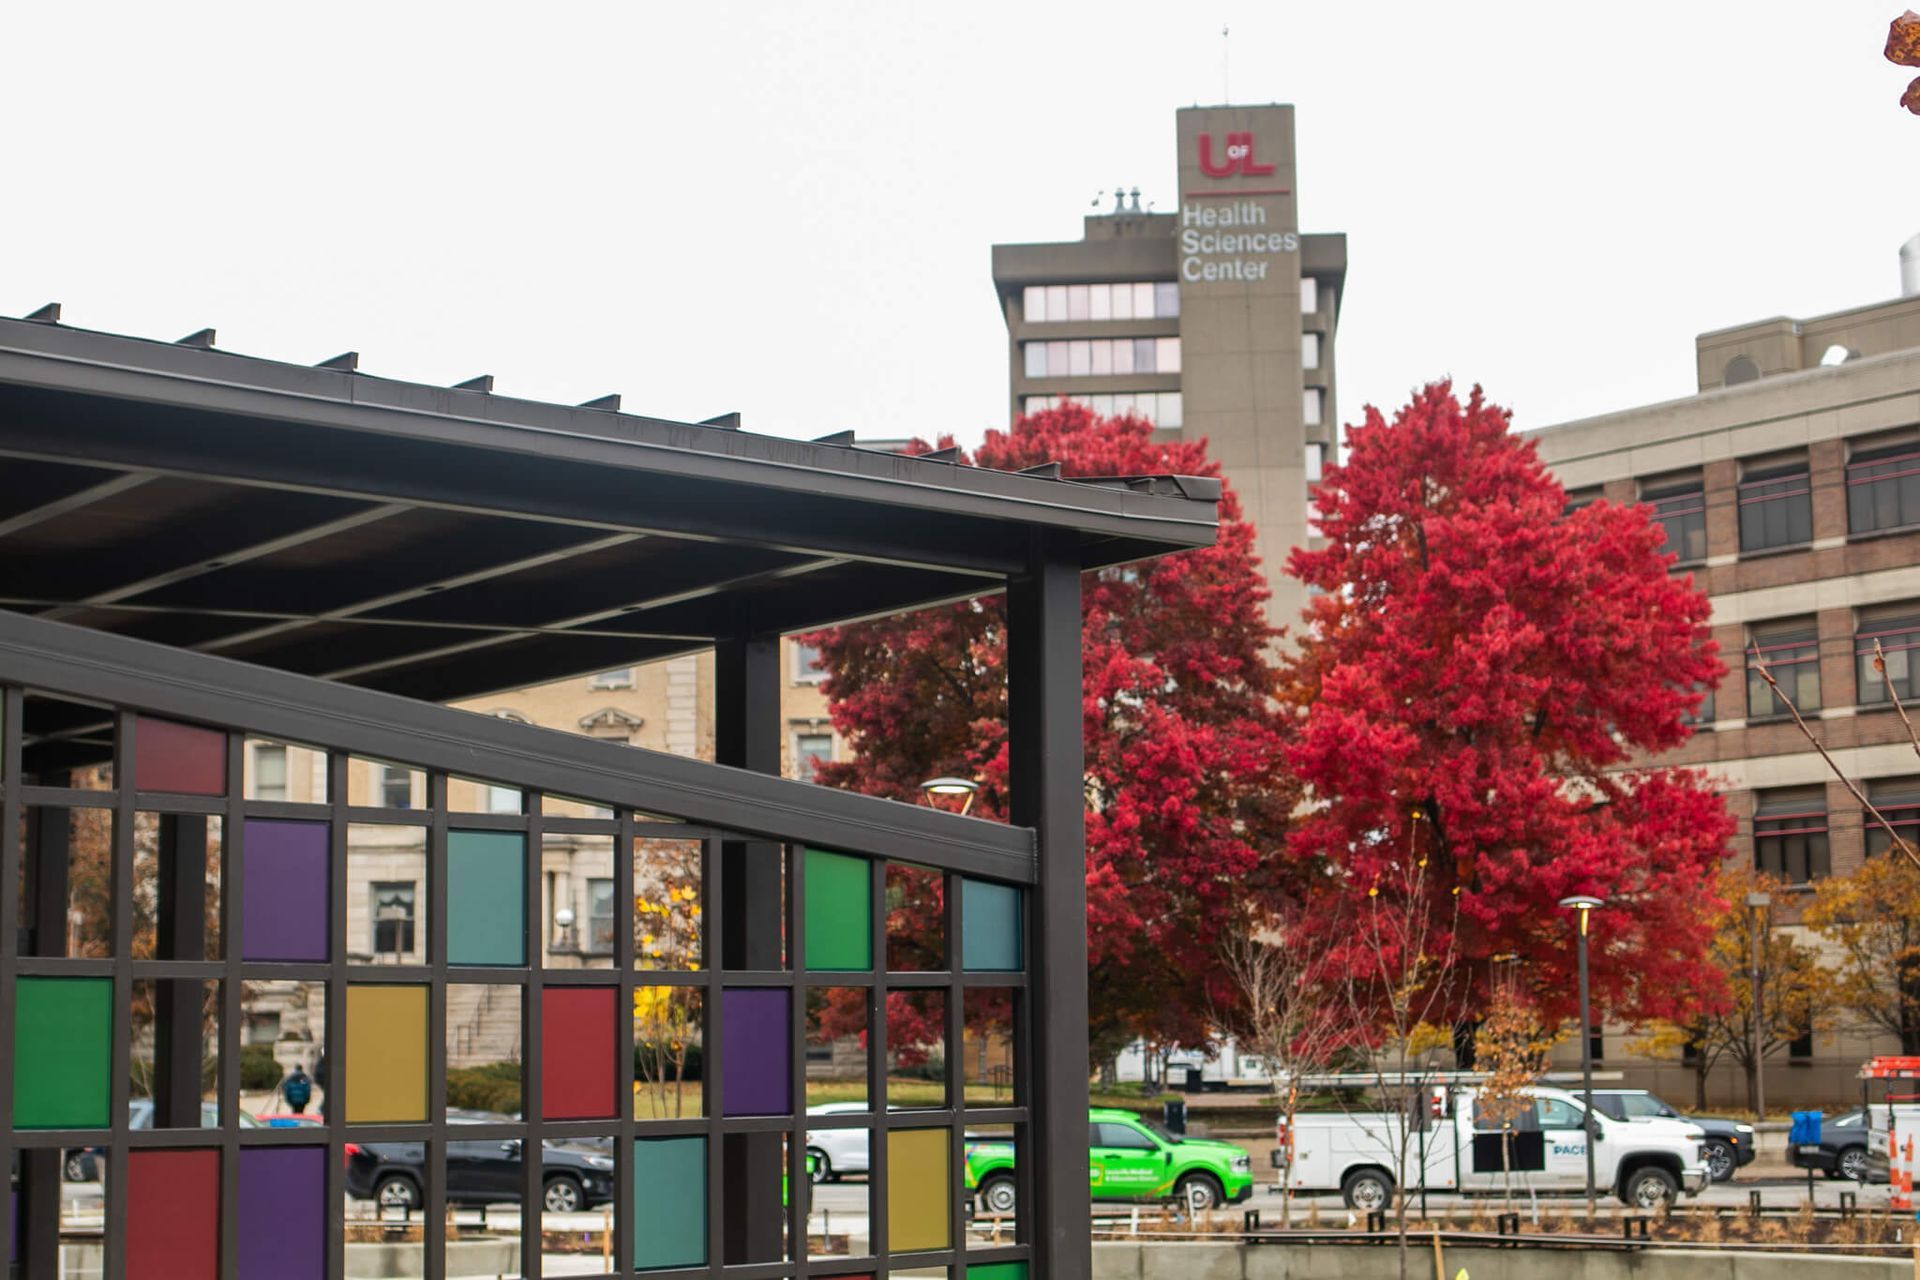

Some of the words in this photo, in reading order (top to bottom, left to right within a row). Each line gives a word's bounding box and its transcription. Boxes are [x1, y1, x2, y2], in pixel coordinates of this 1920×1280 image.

[1182, 203, 1266, 226] Health
[1182, 229, 1298, 253] Sciences
[1182, 257, 1268, 281] Center
